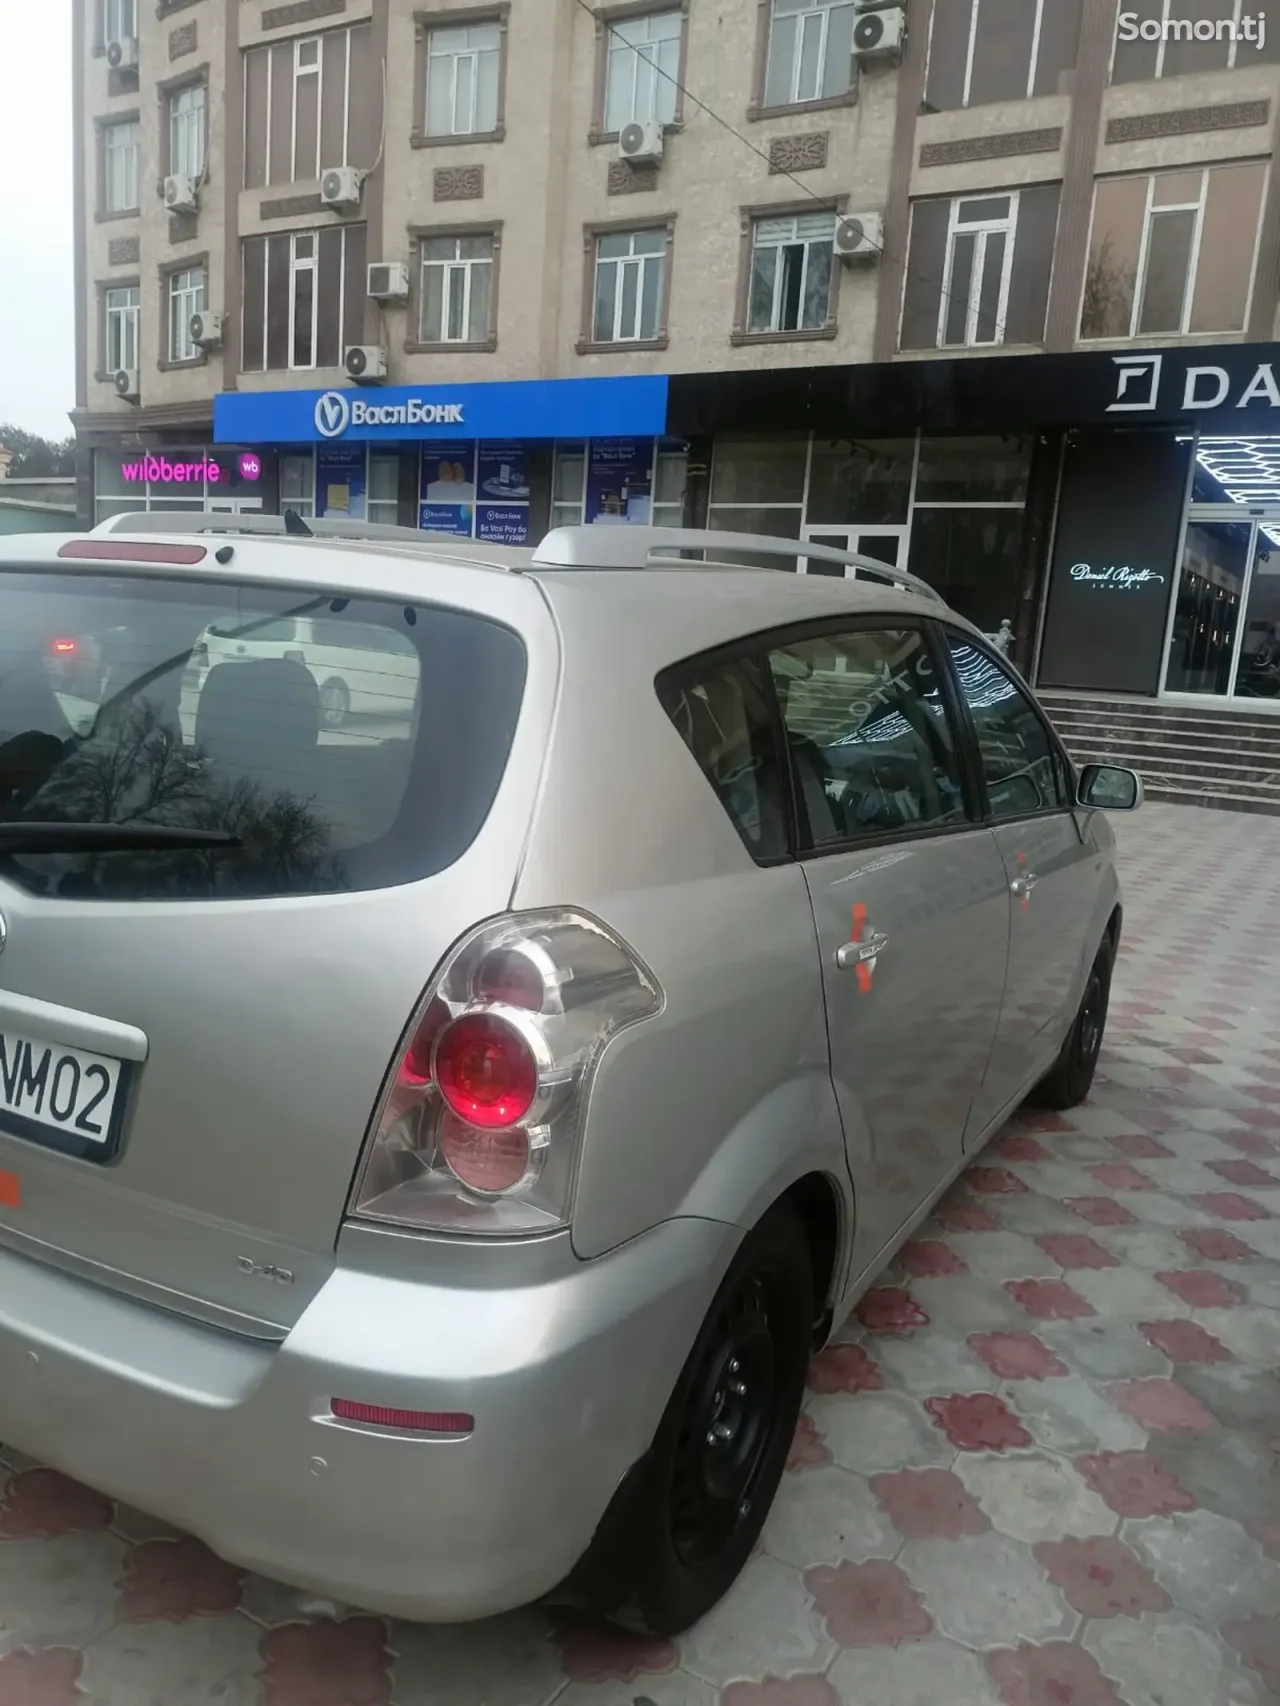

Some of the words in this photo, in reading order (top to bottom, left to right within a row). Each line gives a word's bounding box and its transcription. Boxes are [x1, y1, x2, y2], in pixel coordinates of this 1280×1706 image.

[1180, 363, 1280, 410] DA
[351, 399, 465, 425] ВаслБонк
[242, 460, 259, 473] wb
